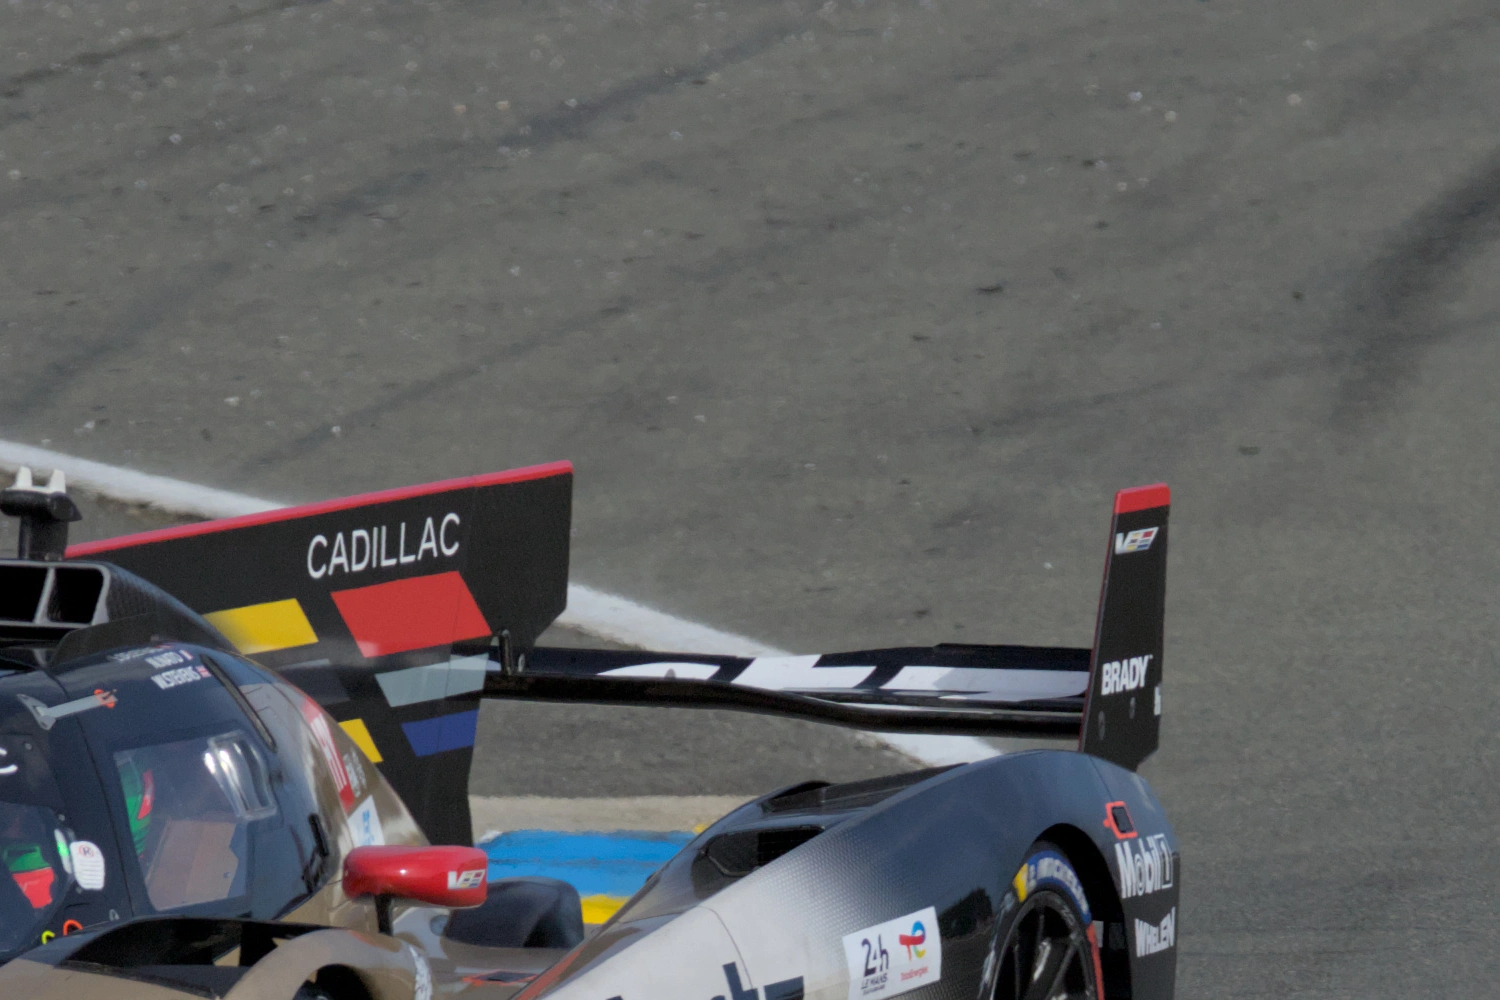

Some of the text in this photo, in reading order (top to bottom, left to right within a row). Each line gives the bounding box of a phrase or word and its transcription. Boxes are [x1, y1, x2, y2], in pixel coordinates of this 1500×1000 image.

[307, 513, 460, 579] CADILLAC
[1101, 656, 1151, 695] BRADY
[1114, 835, 1162, 899] Mobil
[1134, 906, 1176, 958] WHELEN
